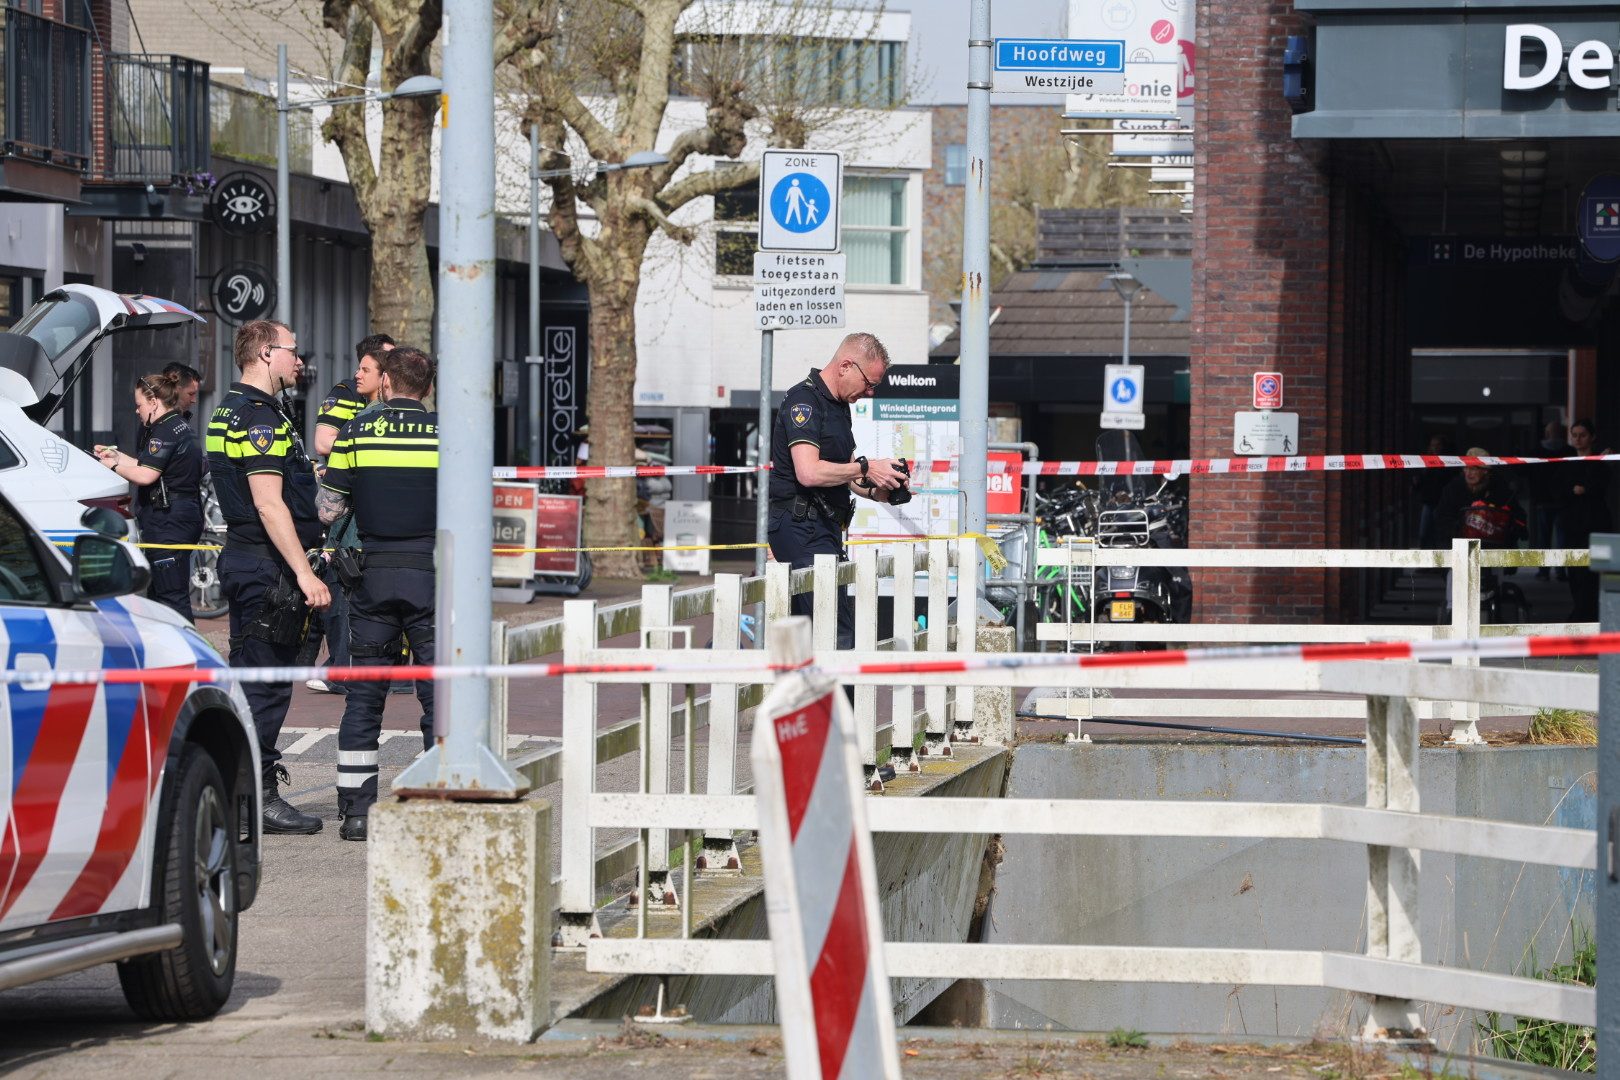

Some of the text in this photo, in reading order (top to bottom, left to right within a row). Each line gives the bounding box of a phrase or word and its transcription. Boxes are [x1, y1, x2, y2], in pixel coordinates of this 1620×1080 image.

[1013, 46, 1106, 66] Hoofdweg
[1504, 23, 1614, 90] De
[1025, 75, 1094, 91] Westzijde
[785, 157, 818, 168] ZONE
[1464, 244, 1485, 259] De
[775, 254, 825, 266] fietsen
[761, 269, 839, 282] toegestaan
[761, 285, 836, 299] uitgezonderd
[756, 300, 843, 311] laden en lossen
[888, 374, 937, 386] Welkom
[879, 403, 957, 414] Winkelplattegrond
[364, 419, 434, 436] POLITIE
